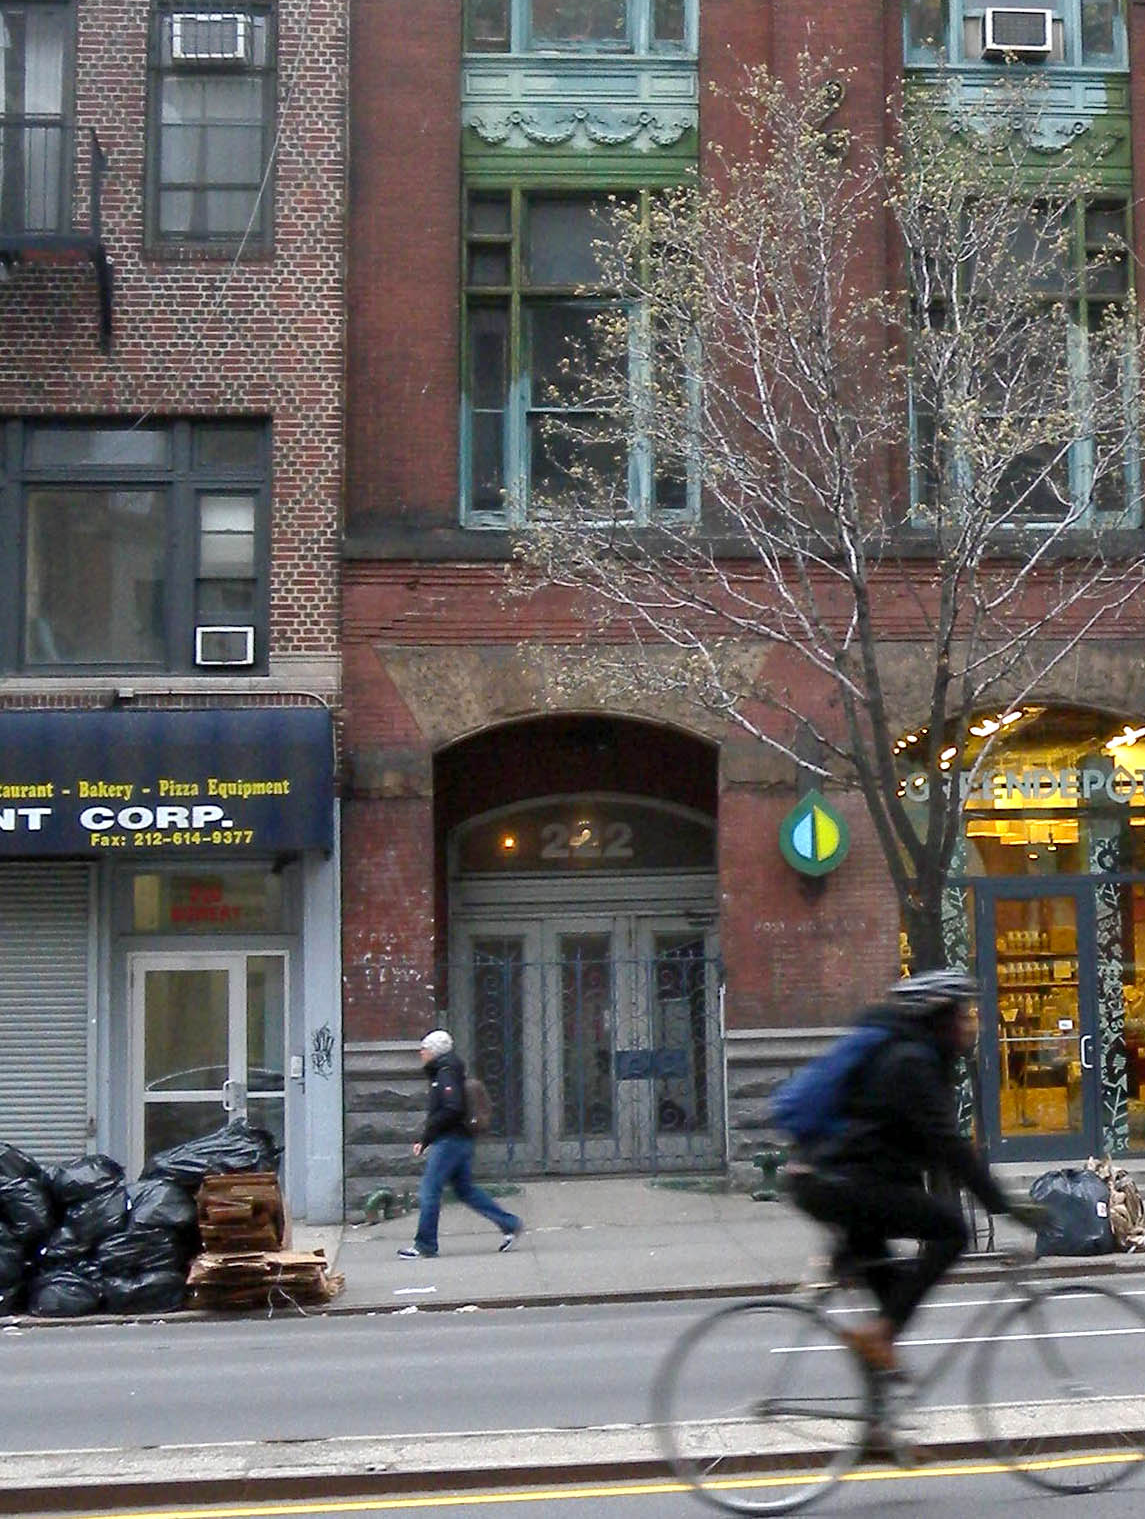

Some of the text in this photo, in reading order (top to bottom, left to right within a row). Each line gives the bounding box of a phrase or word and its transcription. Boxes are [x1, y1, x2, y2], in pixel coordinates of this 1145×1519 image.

[79, 781, 133, 800] Bakery
[159, 780, 198, 796] Pizza
[208, 779, 290, 799] Equipment
[79, 806, 233, 830] CORP.
[91, 831, 254, 846] Fax: 212-614-9377
[541, 822, 634, 858] 222
